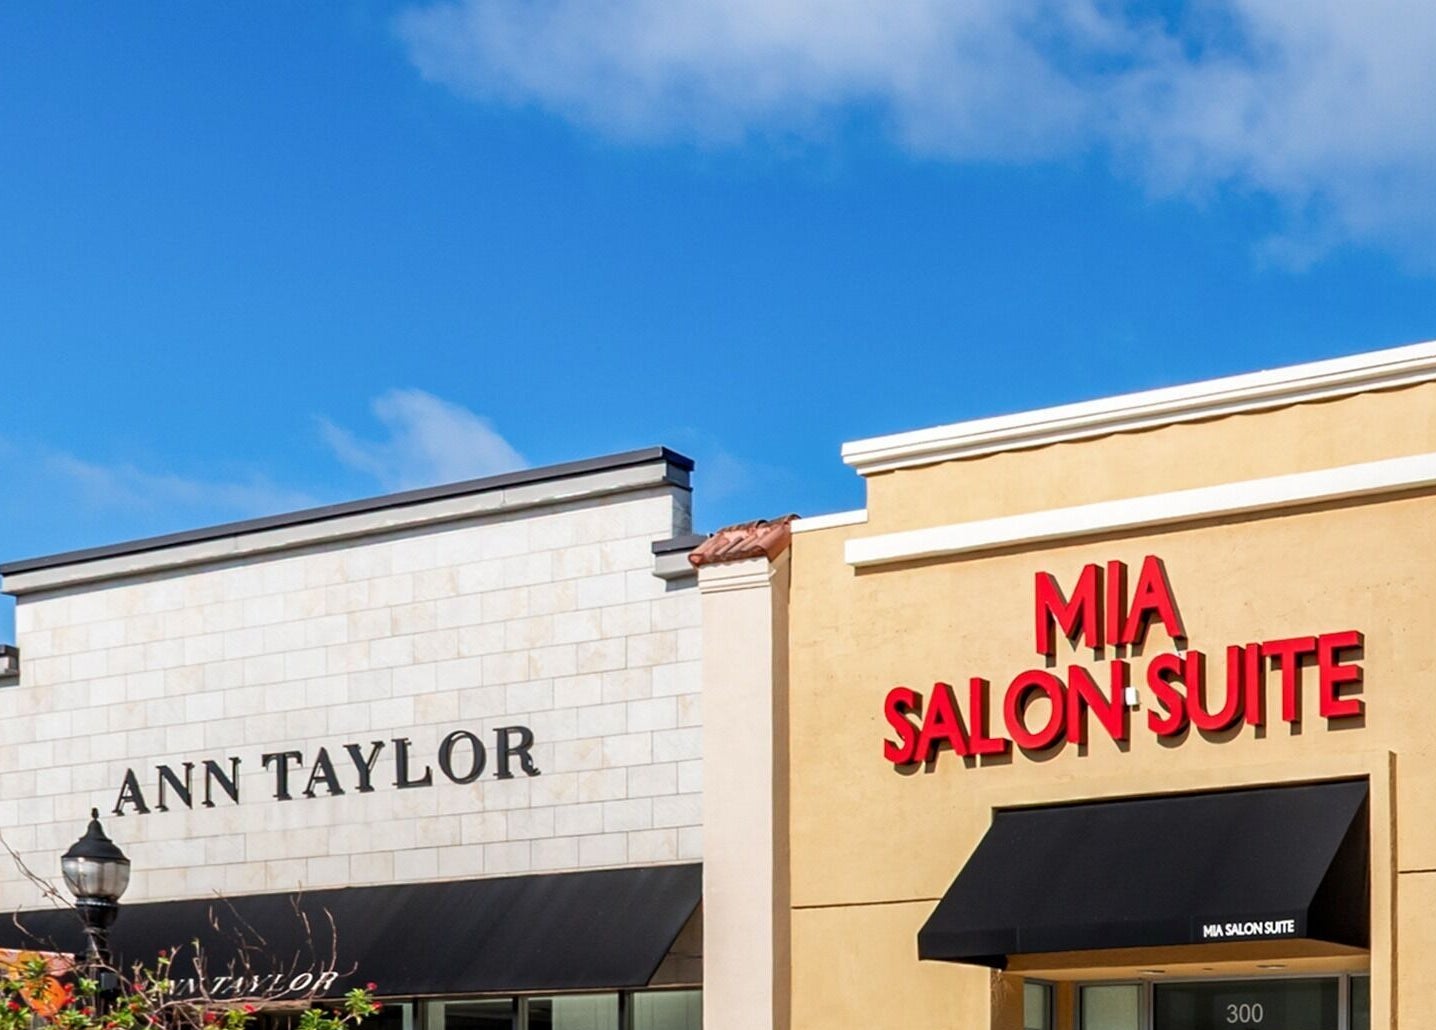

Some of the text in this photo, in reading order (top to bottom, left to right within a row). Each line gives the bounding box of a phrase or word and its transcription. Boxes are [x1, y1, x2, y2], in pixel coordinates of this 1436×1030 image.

[1035, 555, 1187, 657] MIA
[884, 630, 1365, 765] SALON SUITE
[112, 726, 541, 816] ANN TAYLOR
[1203, 919, 1295, 938] MIA SALON SUITE
[1227, 1003, 1263, 1023] 300
